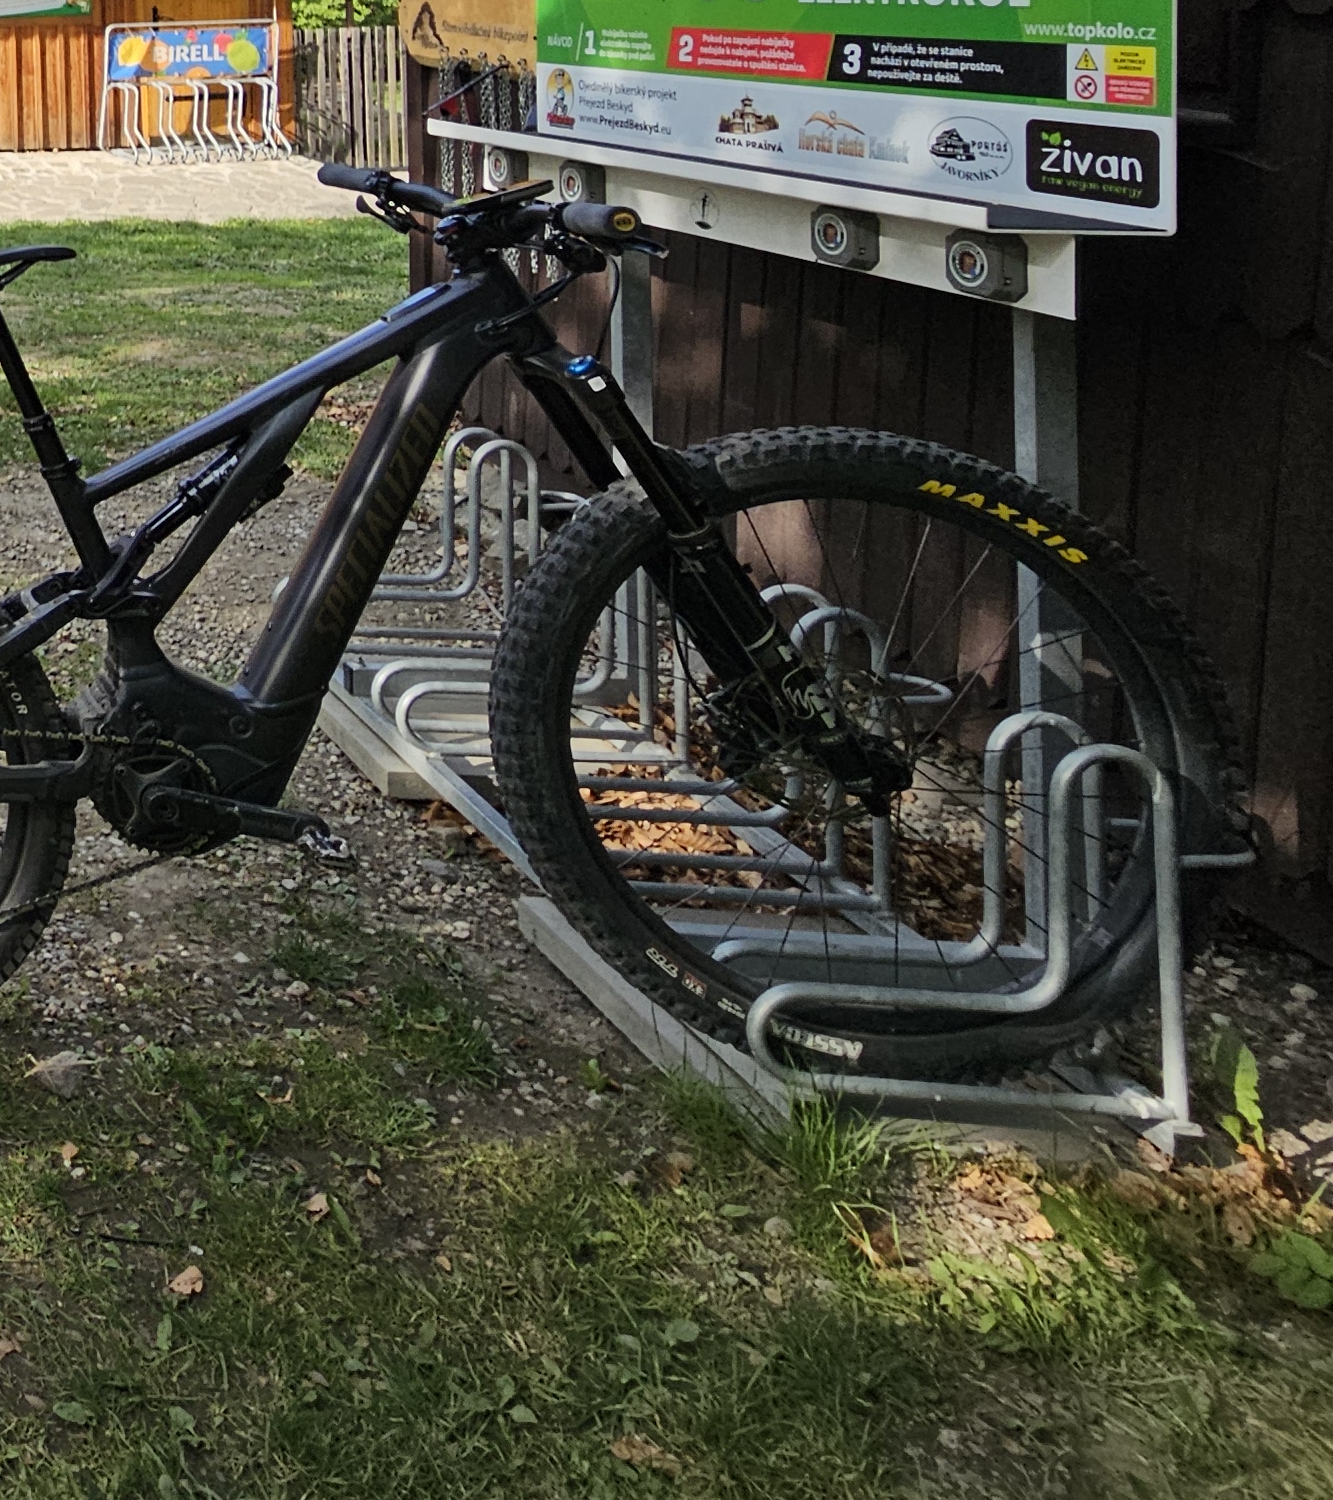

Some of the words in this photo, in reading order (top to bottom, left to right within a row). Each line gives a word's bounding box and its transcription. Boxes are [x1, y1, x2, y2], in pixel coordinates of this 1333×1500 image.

[547, 34, 573, 47] NÁVOD
[1025, 21, 1157, 41] www.topkolo.cz
[584, 30, 596, 55] 1
[679, 34, 694, 62] 2
[872, 42, 880, 51] V
[881, 42, 916, 55] případě,
[917, 44, 927, 55] že
[929, 46, 939, 55] se
[940, 46, 974, 57] stanice
[153, 44, 224, 63] BIRELL
[842, 43, 862, 75] 3
[867, 68, 922, 82] nepoužívejte
[923, 73, 933, 82] za
[934, 71, 963, 83] deště.
[870, 56, 902, 65] nachází
[910, 57, 958, 69] otevřeném
[960, 62, 1005, 74] prostoru,
[578, 80, 613, 95] Ojedinělý
[614, 84, 646, 99] bikerský
[647, 88, 677, 102] projekt
[607, 100, 634, 114] Beskyd
[579, 114, 672, 135] www.PrejezdBeskyd.eu
[715, 136, 743, 147] CHATA
[745, 140, 784, 153] PRAŠIVÁ
[836, 132, 865, 158] chata
[940, 161, 1000, 183] JAVORNÍKY
[1066, 179, 1100, 191] vegan
[1102, 184, 1143, 199] energy
[314, 403, 439, 638] SPECIALIZED
[918, 479, 1088, 564] MAXXIS
[770, 1018, 864, 1061] ASSEGA
